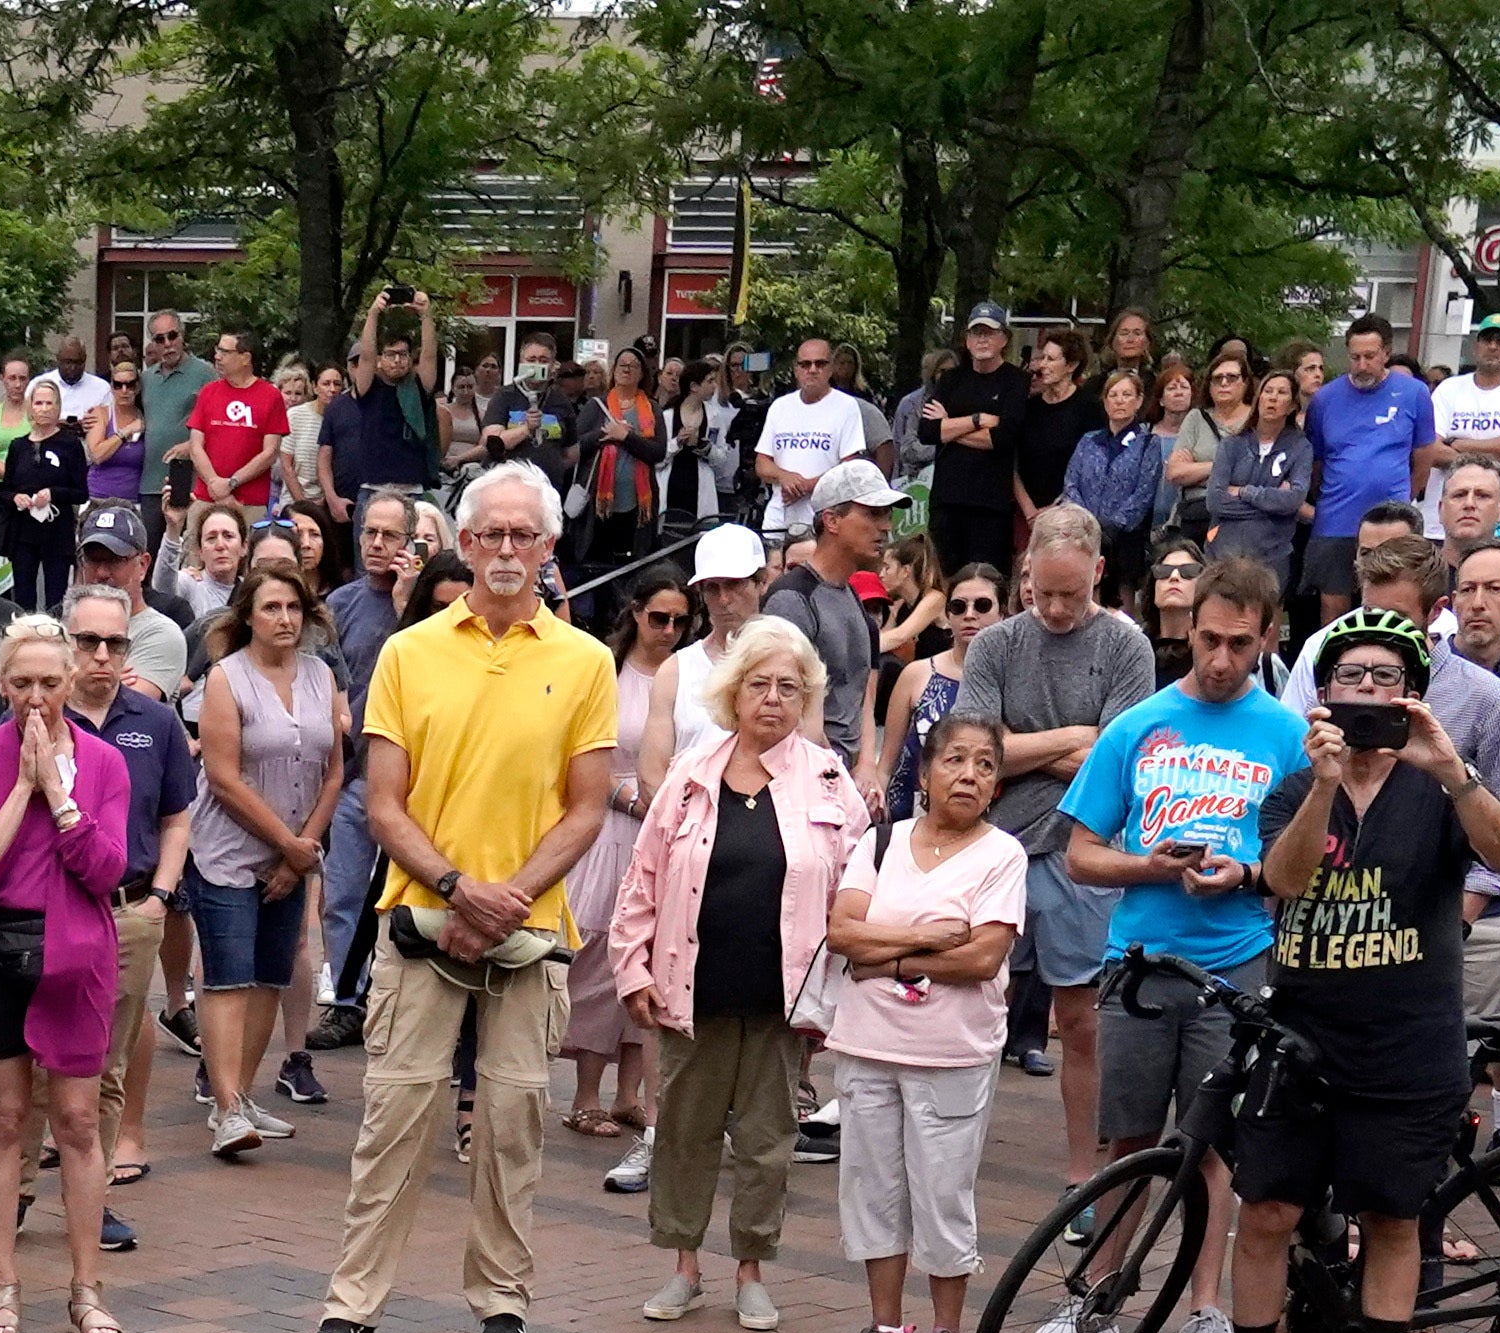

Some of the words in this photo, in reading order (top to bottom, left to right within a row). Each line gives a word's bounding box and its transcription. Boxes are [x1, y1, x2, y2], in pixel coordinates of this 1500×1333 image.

[775, 438, 831, 451] STRONG
[1134, 754, 1273, 802] SUMMER
[1141, 784, 1250, 848] Games
[1324, 866, 1388, 902] MAN.
[1311, 897, 1397, 936] MYTH.
[1276, 933, 1303, 968] HE
[1308, 927, 1423, 969] LEGEND.
